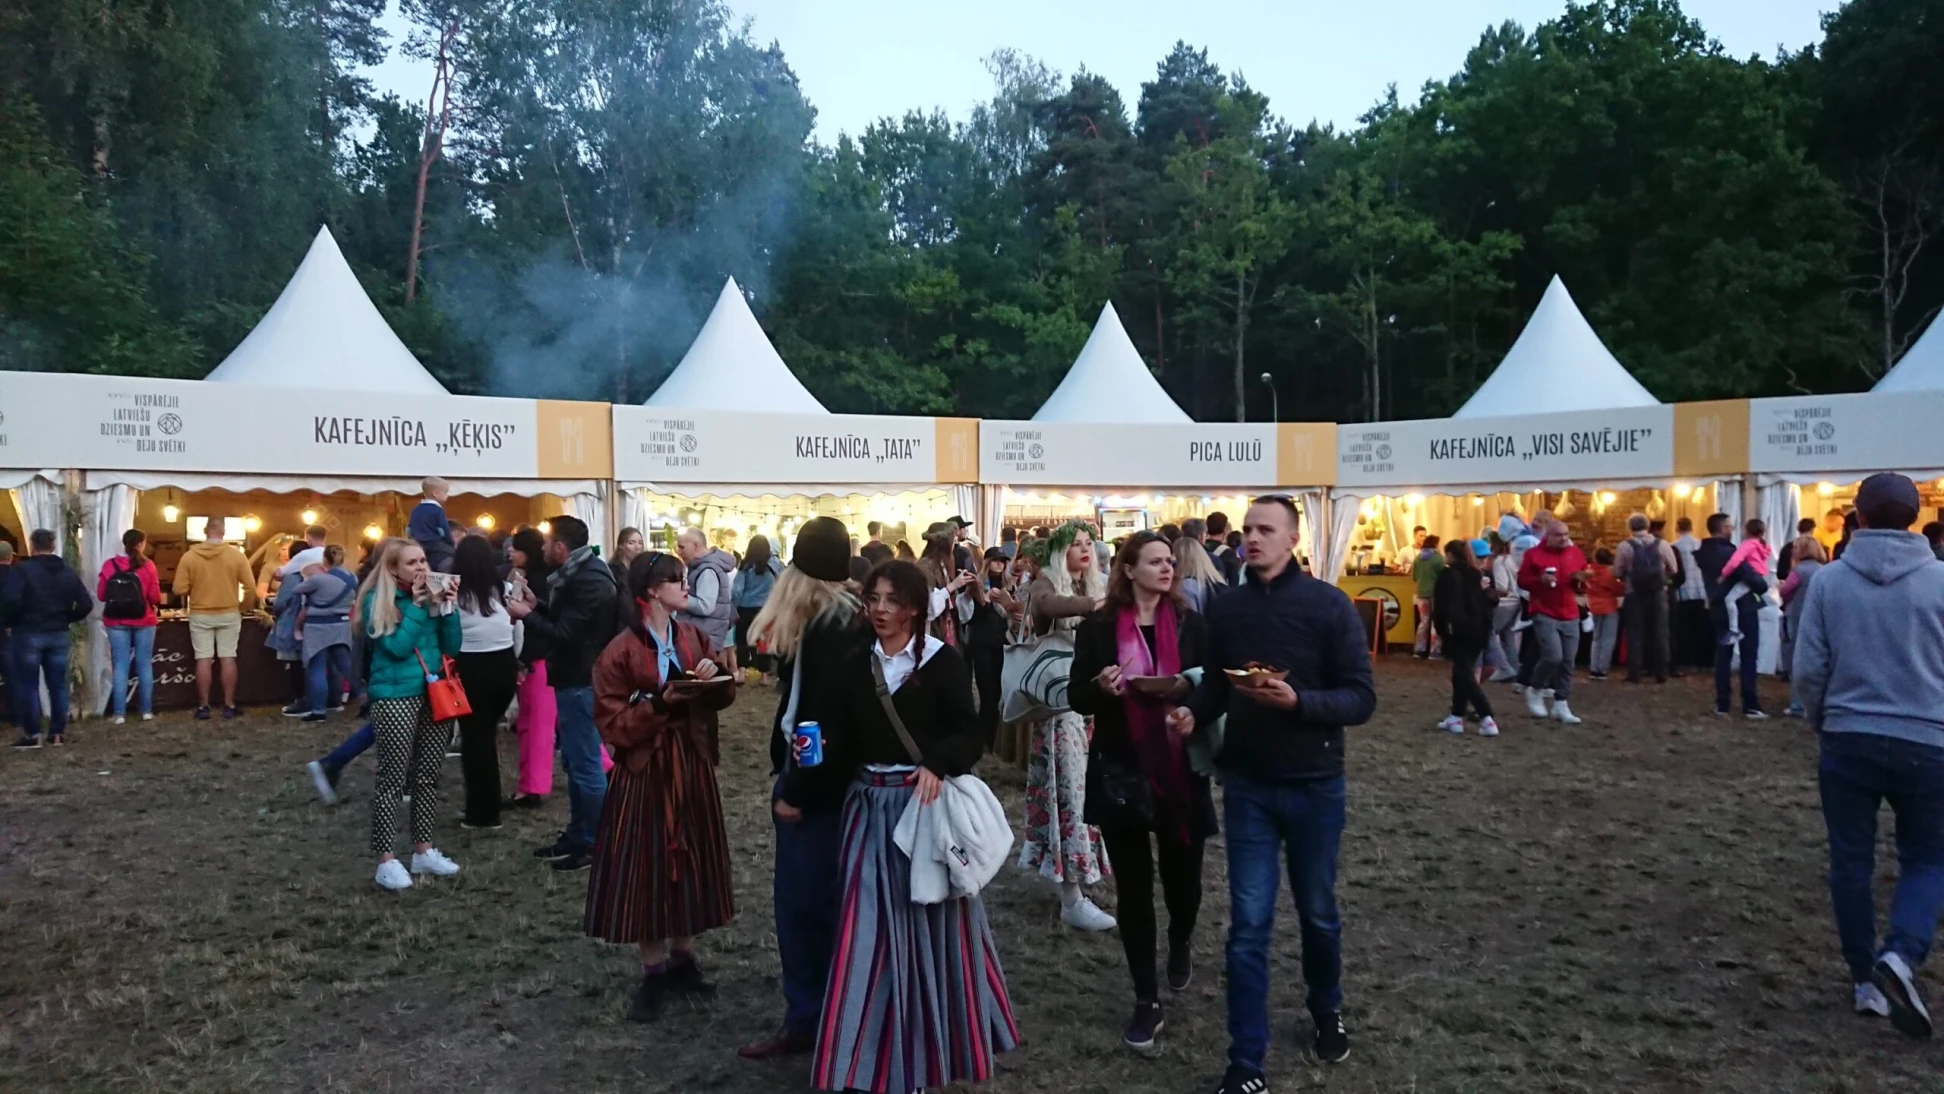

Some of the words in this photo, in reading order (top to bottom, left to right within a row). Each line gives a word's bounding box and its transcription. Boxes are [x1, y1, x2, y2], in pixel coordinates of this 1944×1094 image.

[134, 393, 179, 408] VISPĀRĒJIE
[113, 407, 150, 422] LATVIEŠU
[100, 422, 136, 436] DZIESMU
[139, 424, 150, 437] UN
[314, 416, 427, 447] KAFEJNĪCA
[136, 439, 155, 452] DEJU
[158, 439, 185, 453] SVĒTKI
[796, 434, 870, 459] KAFEJNĪCA
[1191, 441, 1222, 461] PICA
[1229, 438, 1261, 461] LULŪ
[1430, 433, 1515, 460] KAFEJNĪCA
[125, 666, 197, 704] gršo
